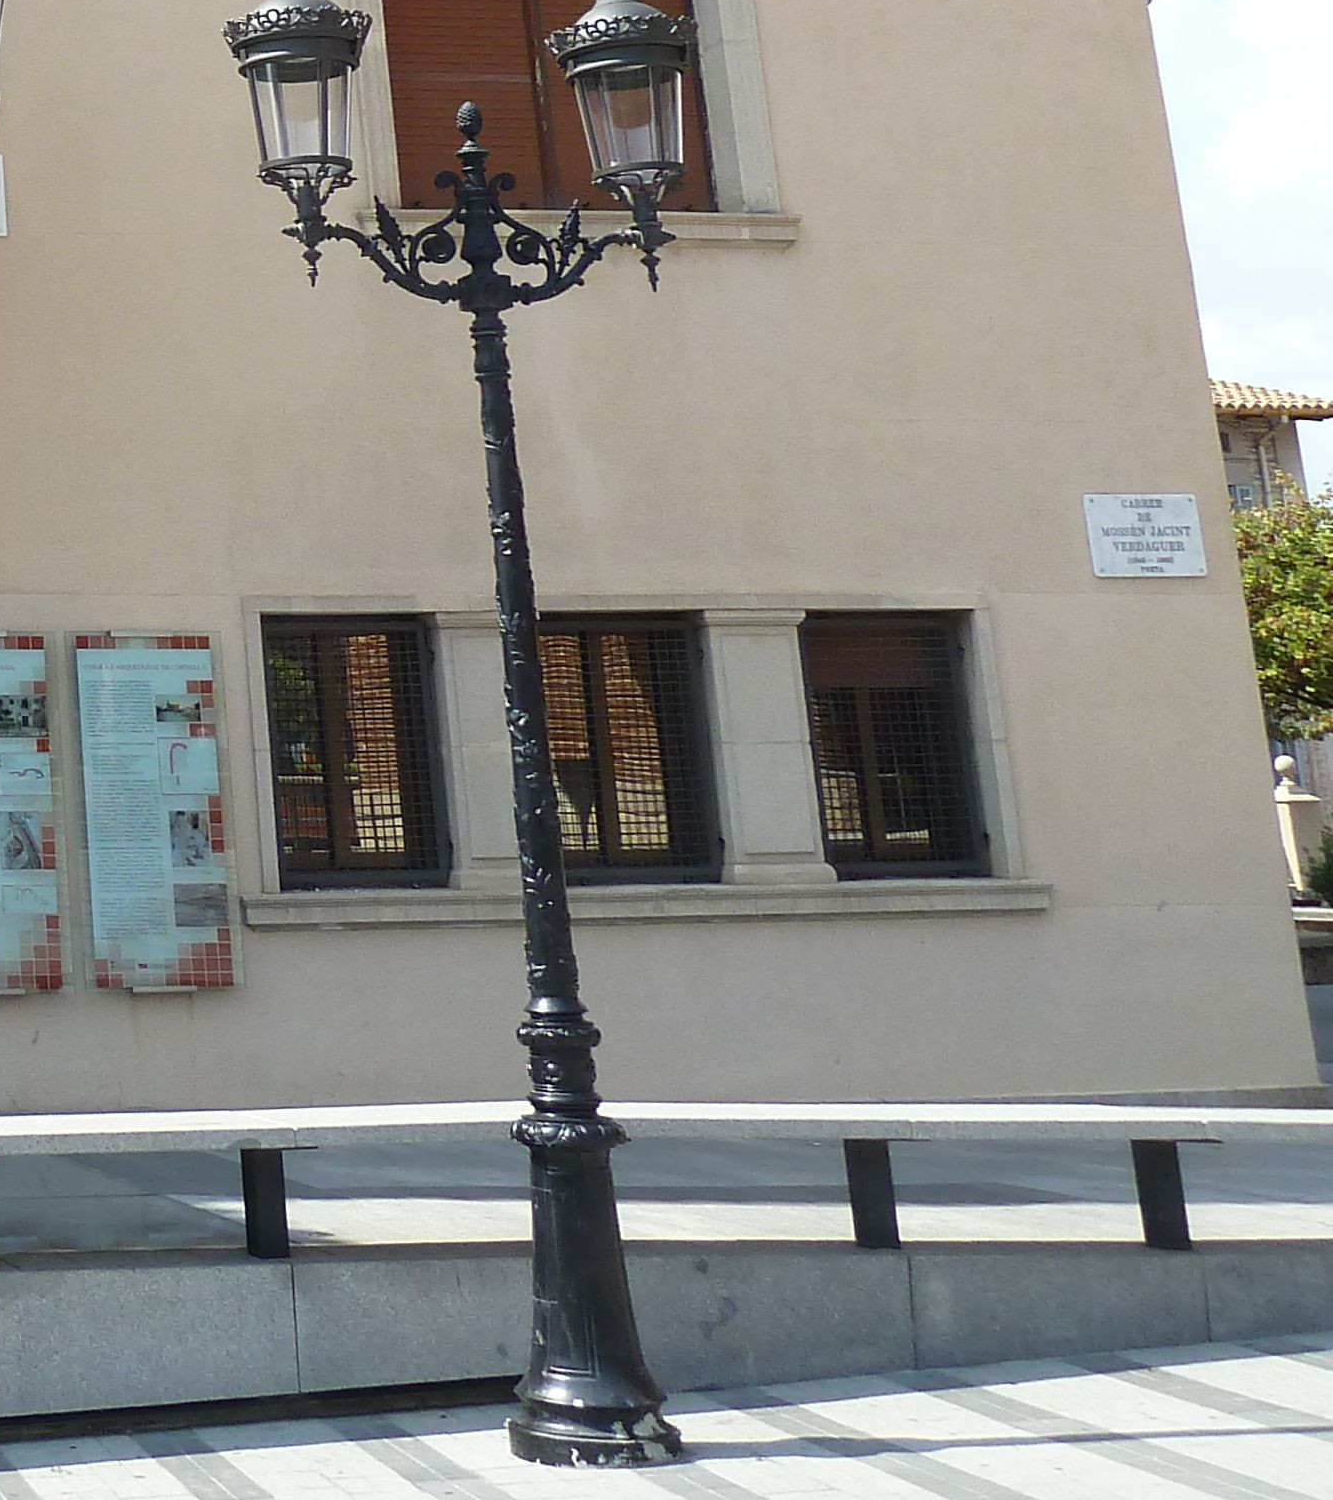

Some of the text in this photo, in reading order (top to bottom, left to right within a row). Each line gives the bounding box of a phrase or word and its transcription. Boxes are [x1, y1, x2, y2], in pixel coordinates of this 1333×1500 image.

[1121, 499, 1163, 509] CARRER
[1137, 513, 1152, 522] DE
[1150, 525, 1192, 537] JACINT
[1112, 541, 1185, 551] VERDAGUER
